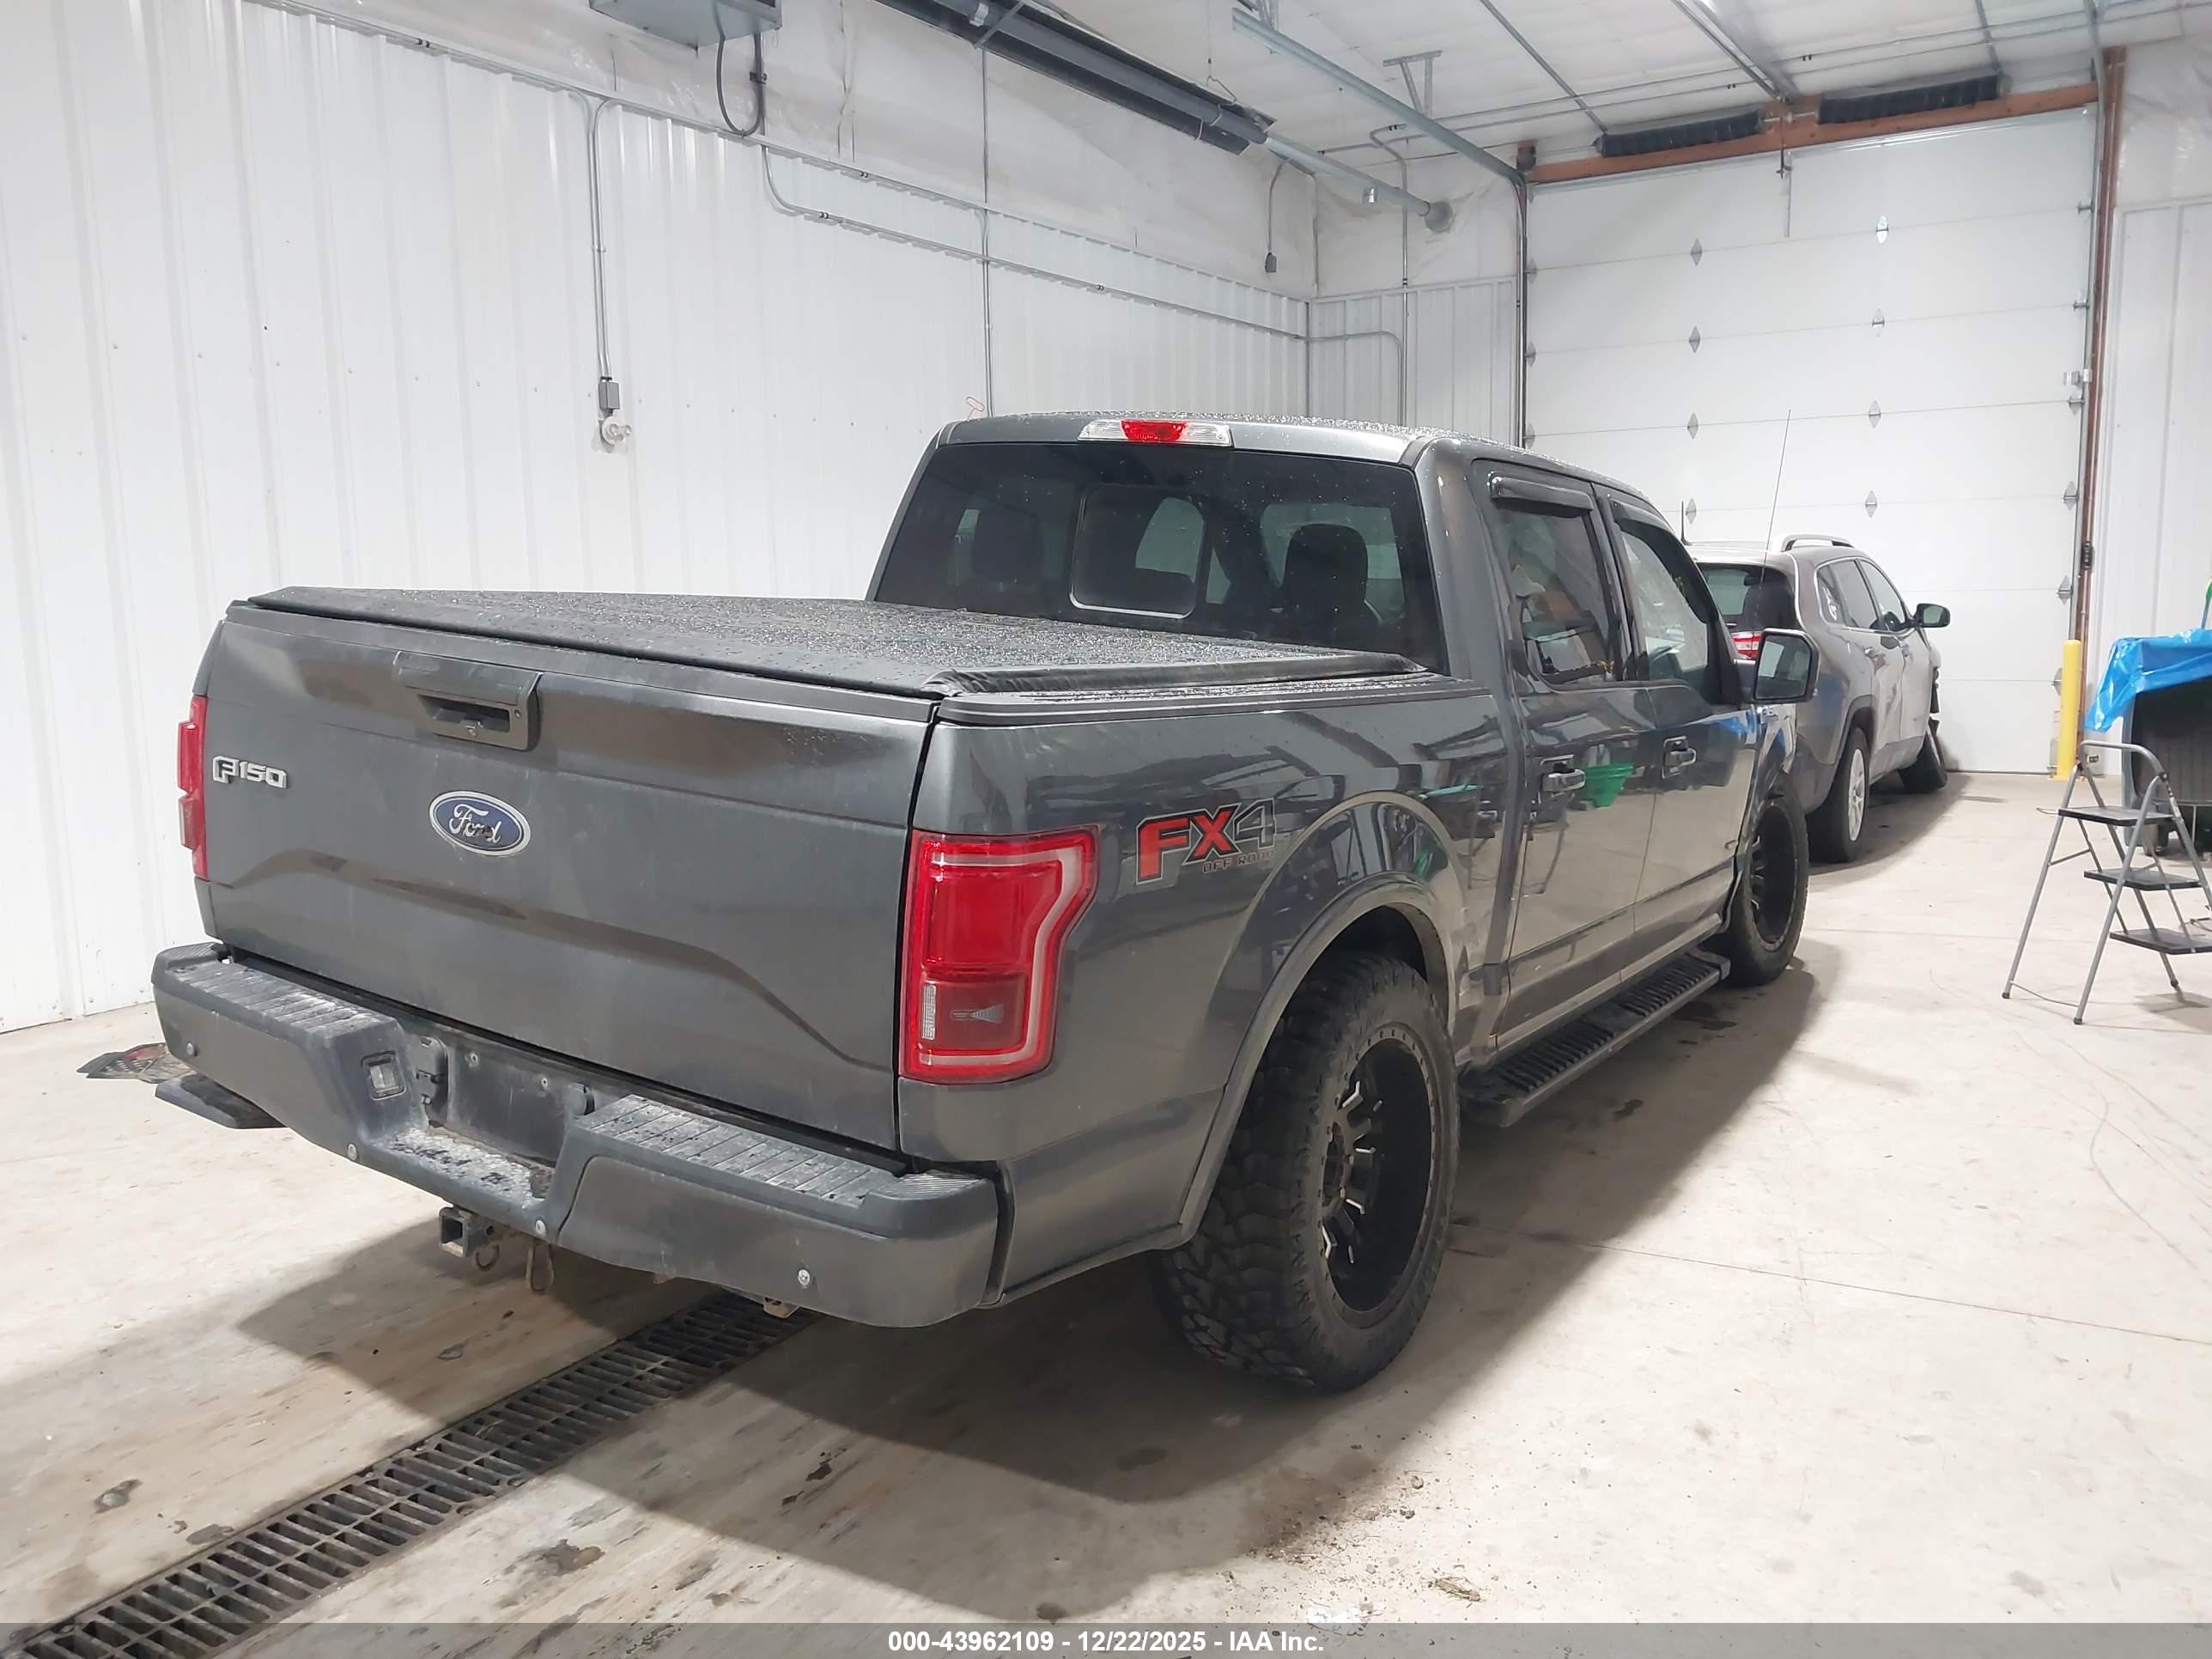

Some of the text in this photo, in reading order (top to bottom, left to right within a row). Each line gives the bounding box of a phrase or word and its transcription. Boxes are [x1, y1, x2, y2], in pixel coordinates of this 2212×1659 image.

[448, 803, 502, 843] Ford
[1135, 796, 1278, 886] FX4
[1202, 858, 1231, 874] OFF
